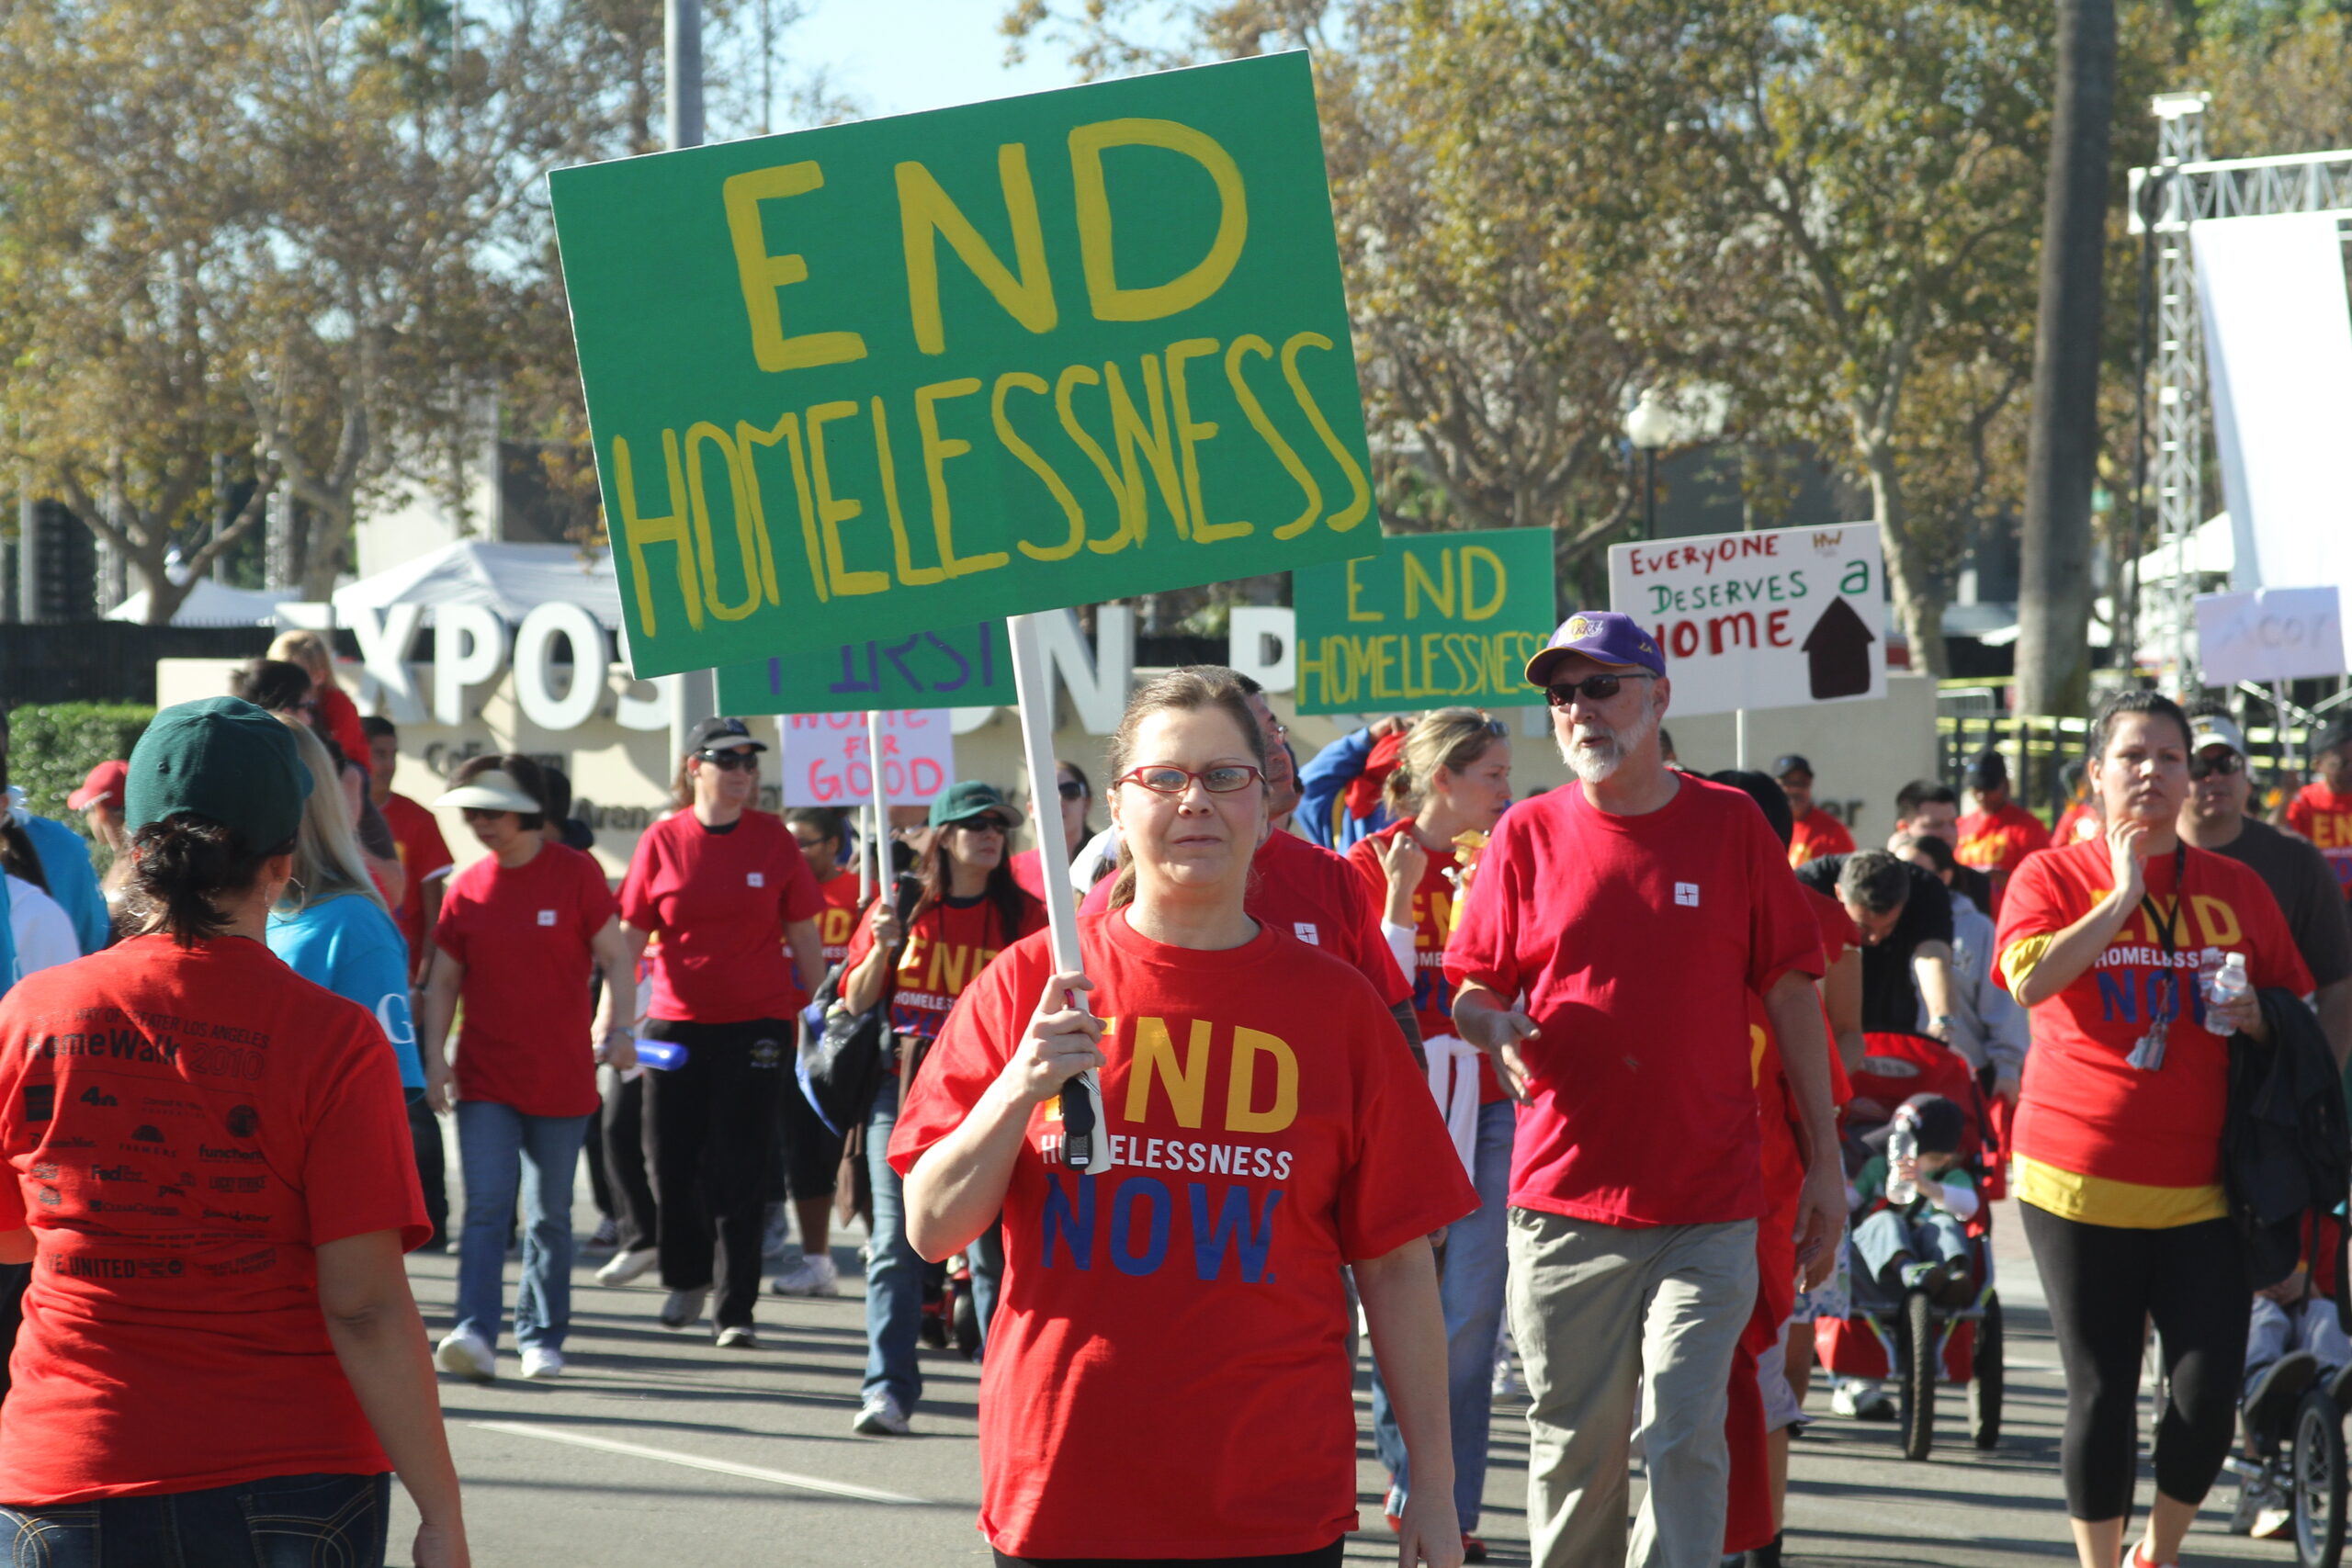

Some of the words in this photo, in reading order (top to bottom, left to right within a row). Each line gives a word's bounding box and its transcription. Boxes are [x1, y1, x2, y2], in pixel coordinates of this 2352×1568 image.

[723, 118, 1248, 372] END
[614, 332, 1372, 637] HOMELESSNESS
[1347, 546, 1507, 622] END
[1648, 570, 1808, 615] DESERVES
[1840, 560, 1869, 594] a
[843, 734, 899, 759] FR
[808, 757, 944, 802] GOOD
[211, 1023, 271, 1050] ANGELES
[188, 1042, 266, 1082] 2010
[1040, 1134, 1294, 1180] HELESSNESS
[69, 1256, 135, 1279] UNITED
